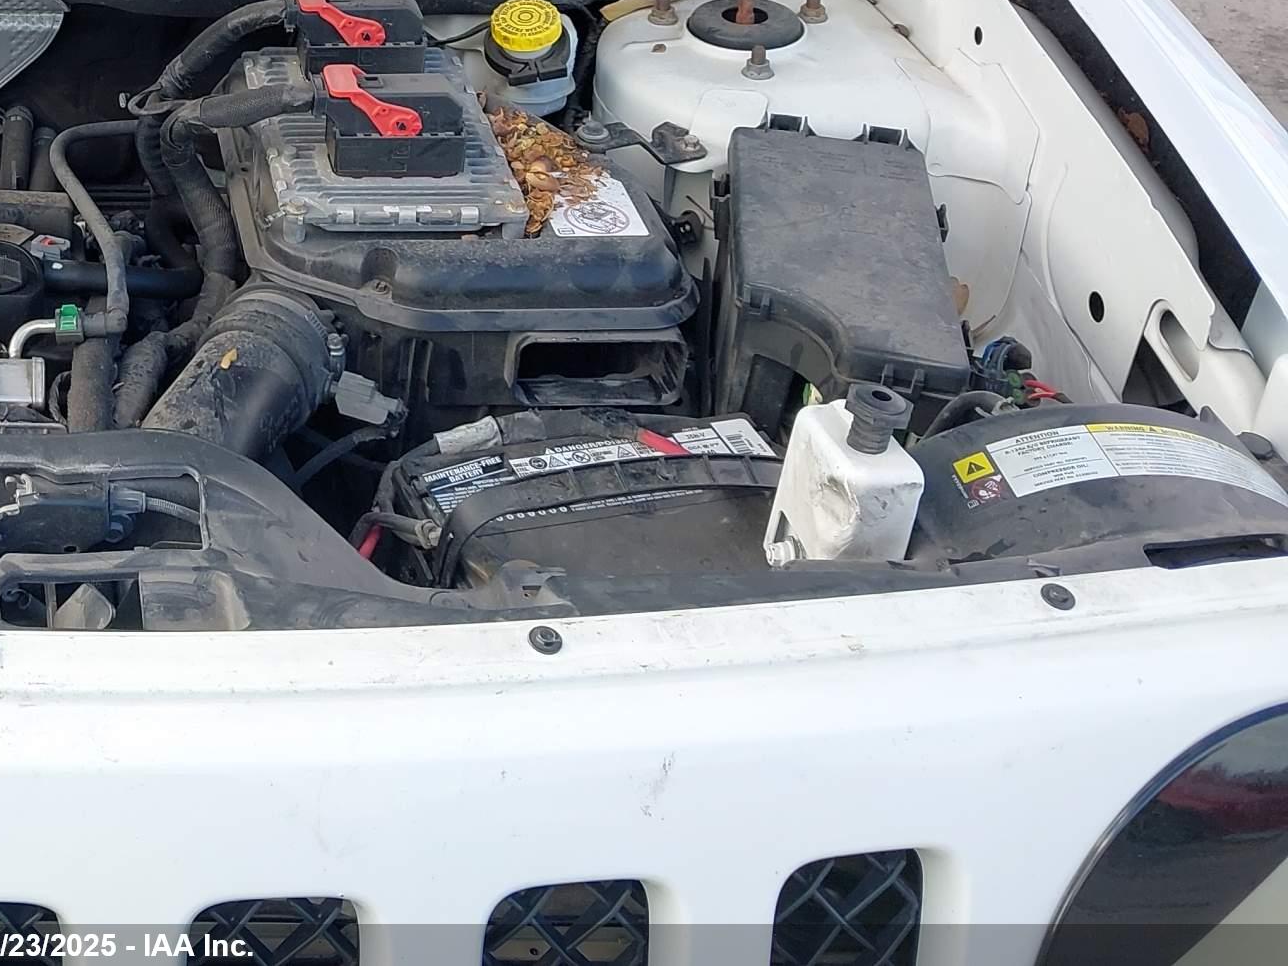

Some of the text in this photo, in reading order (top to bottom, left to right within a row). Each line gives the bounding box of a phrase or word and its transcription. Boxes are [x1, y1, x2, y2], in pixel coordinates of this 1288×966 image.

[1015, 430, 1059, 444] ATTENTION
[424, 455, 503, 483] MAINTENANCE-FREE
[448, 467, 484, 484] BATTERY
